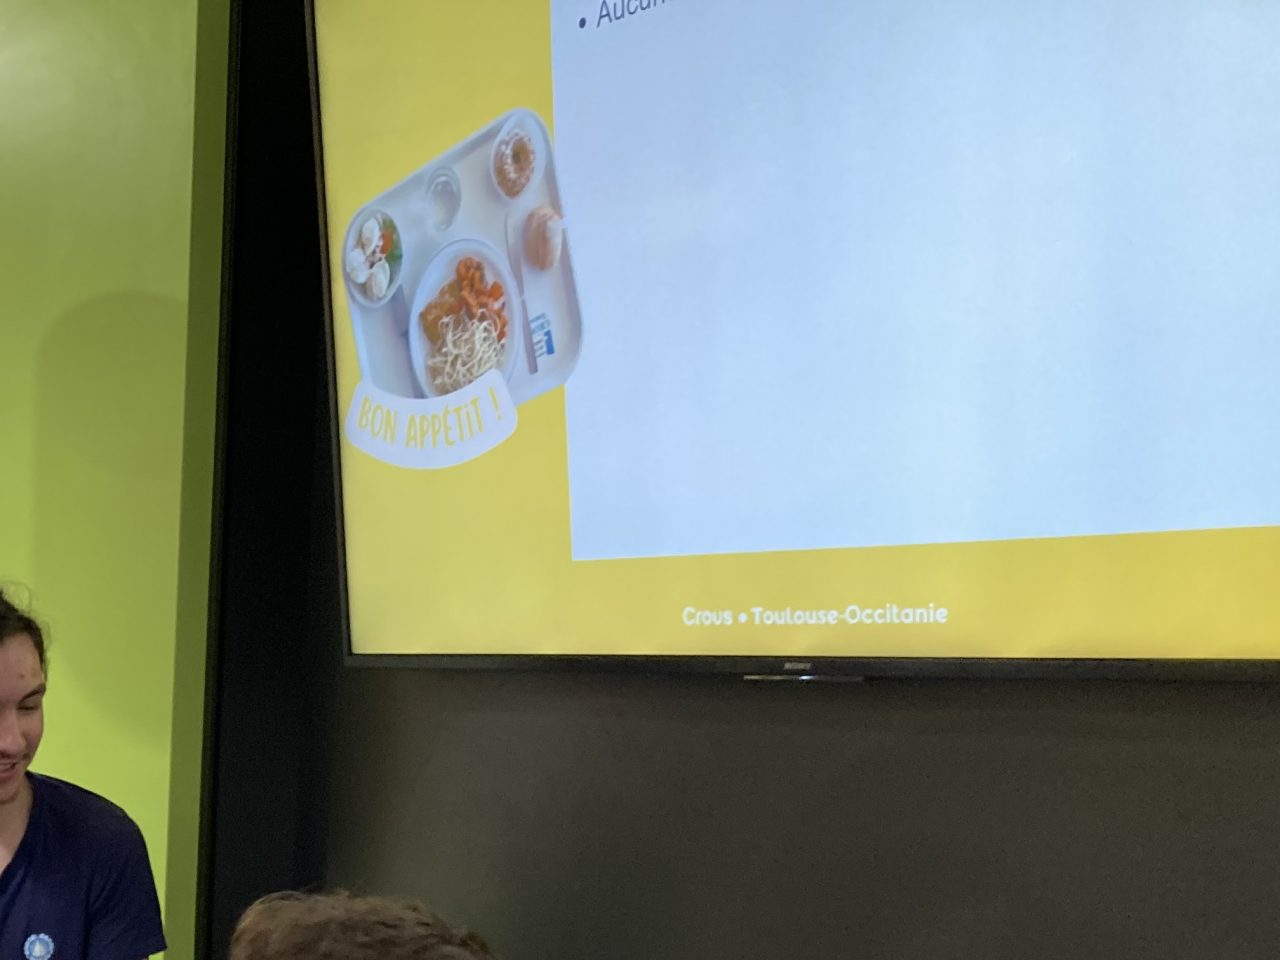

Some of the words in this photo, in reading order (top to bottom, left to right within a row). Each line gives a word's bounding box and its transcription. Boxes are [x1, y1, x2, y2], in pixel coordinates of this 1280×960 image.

[596, 0, 665, 28] Aucu
[357, 395, 399, 447] BON
[682, 606, 733, 625] Crous
[749, 602, 950, 625] Toulouse-Occitanie
